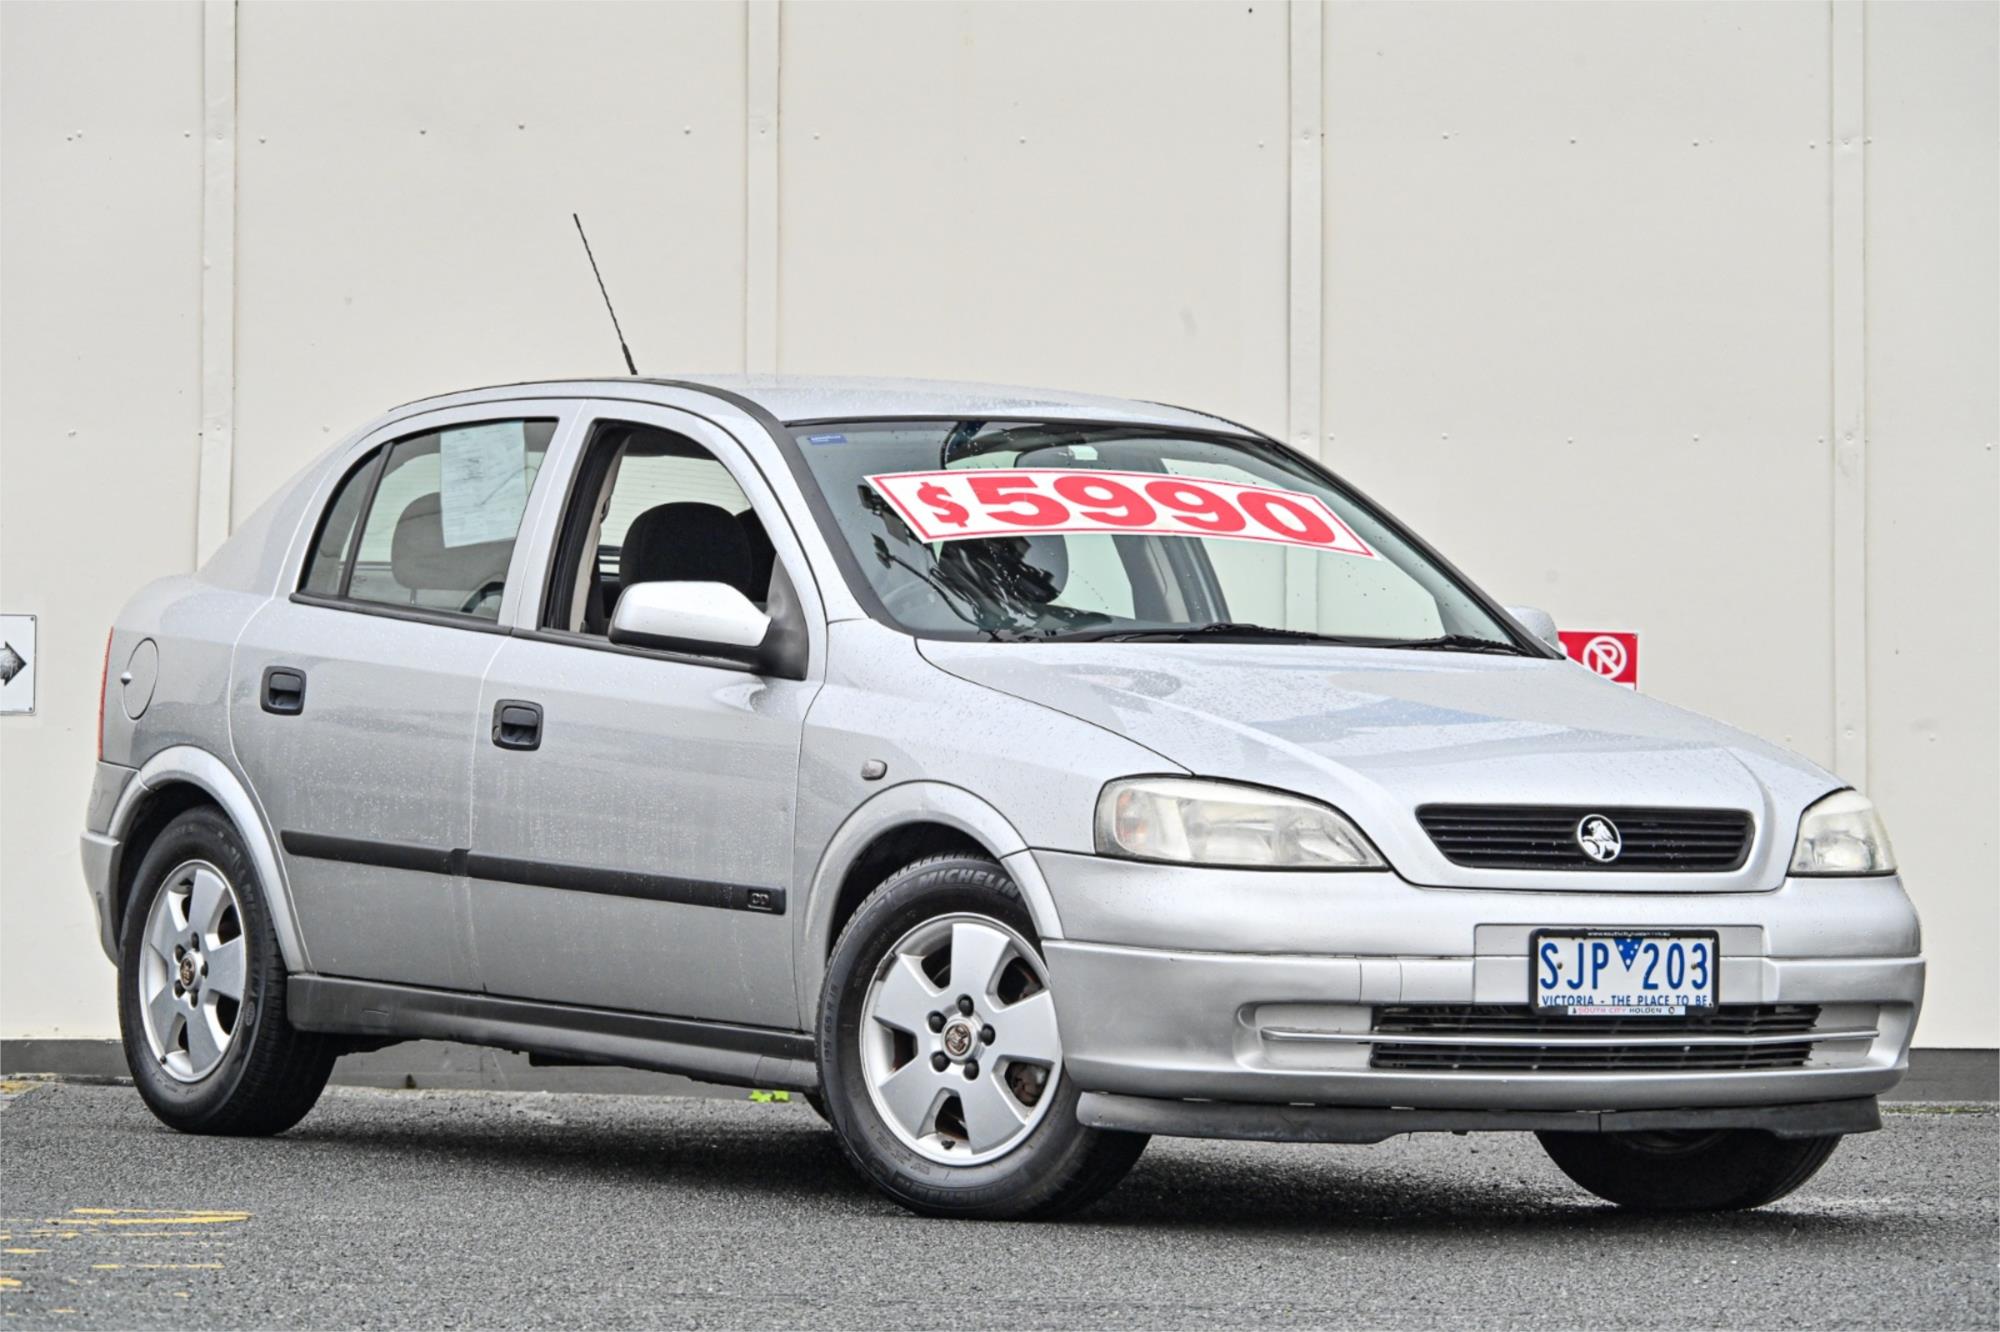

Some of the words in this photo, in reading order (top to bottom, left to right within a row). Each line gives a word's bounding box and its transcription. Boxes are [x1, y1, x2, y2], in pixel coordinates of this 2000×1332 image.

[916, 475, 1337, 544] $5990
[918, 868, 1020, 899] MICHELIN
[1540, 942, 1610, 990] SJP
[1642, 942, 1708, 990] 203
[1542, 995, 1594, 1007] VICTORIA
[1611, 995, 1631, 1007] THE
[1637, 995, 1670, 1007] PLACE
[1676, 995, 1689, 1007] TO
[1578, 1007, 1606, 1015] SOUTH
[1609, 1007, 1627, 1015] CITY
[1629, 1007, 1662, 1015] HOLDEN
